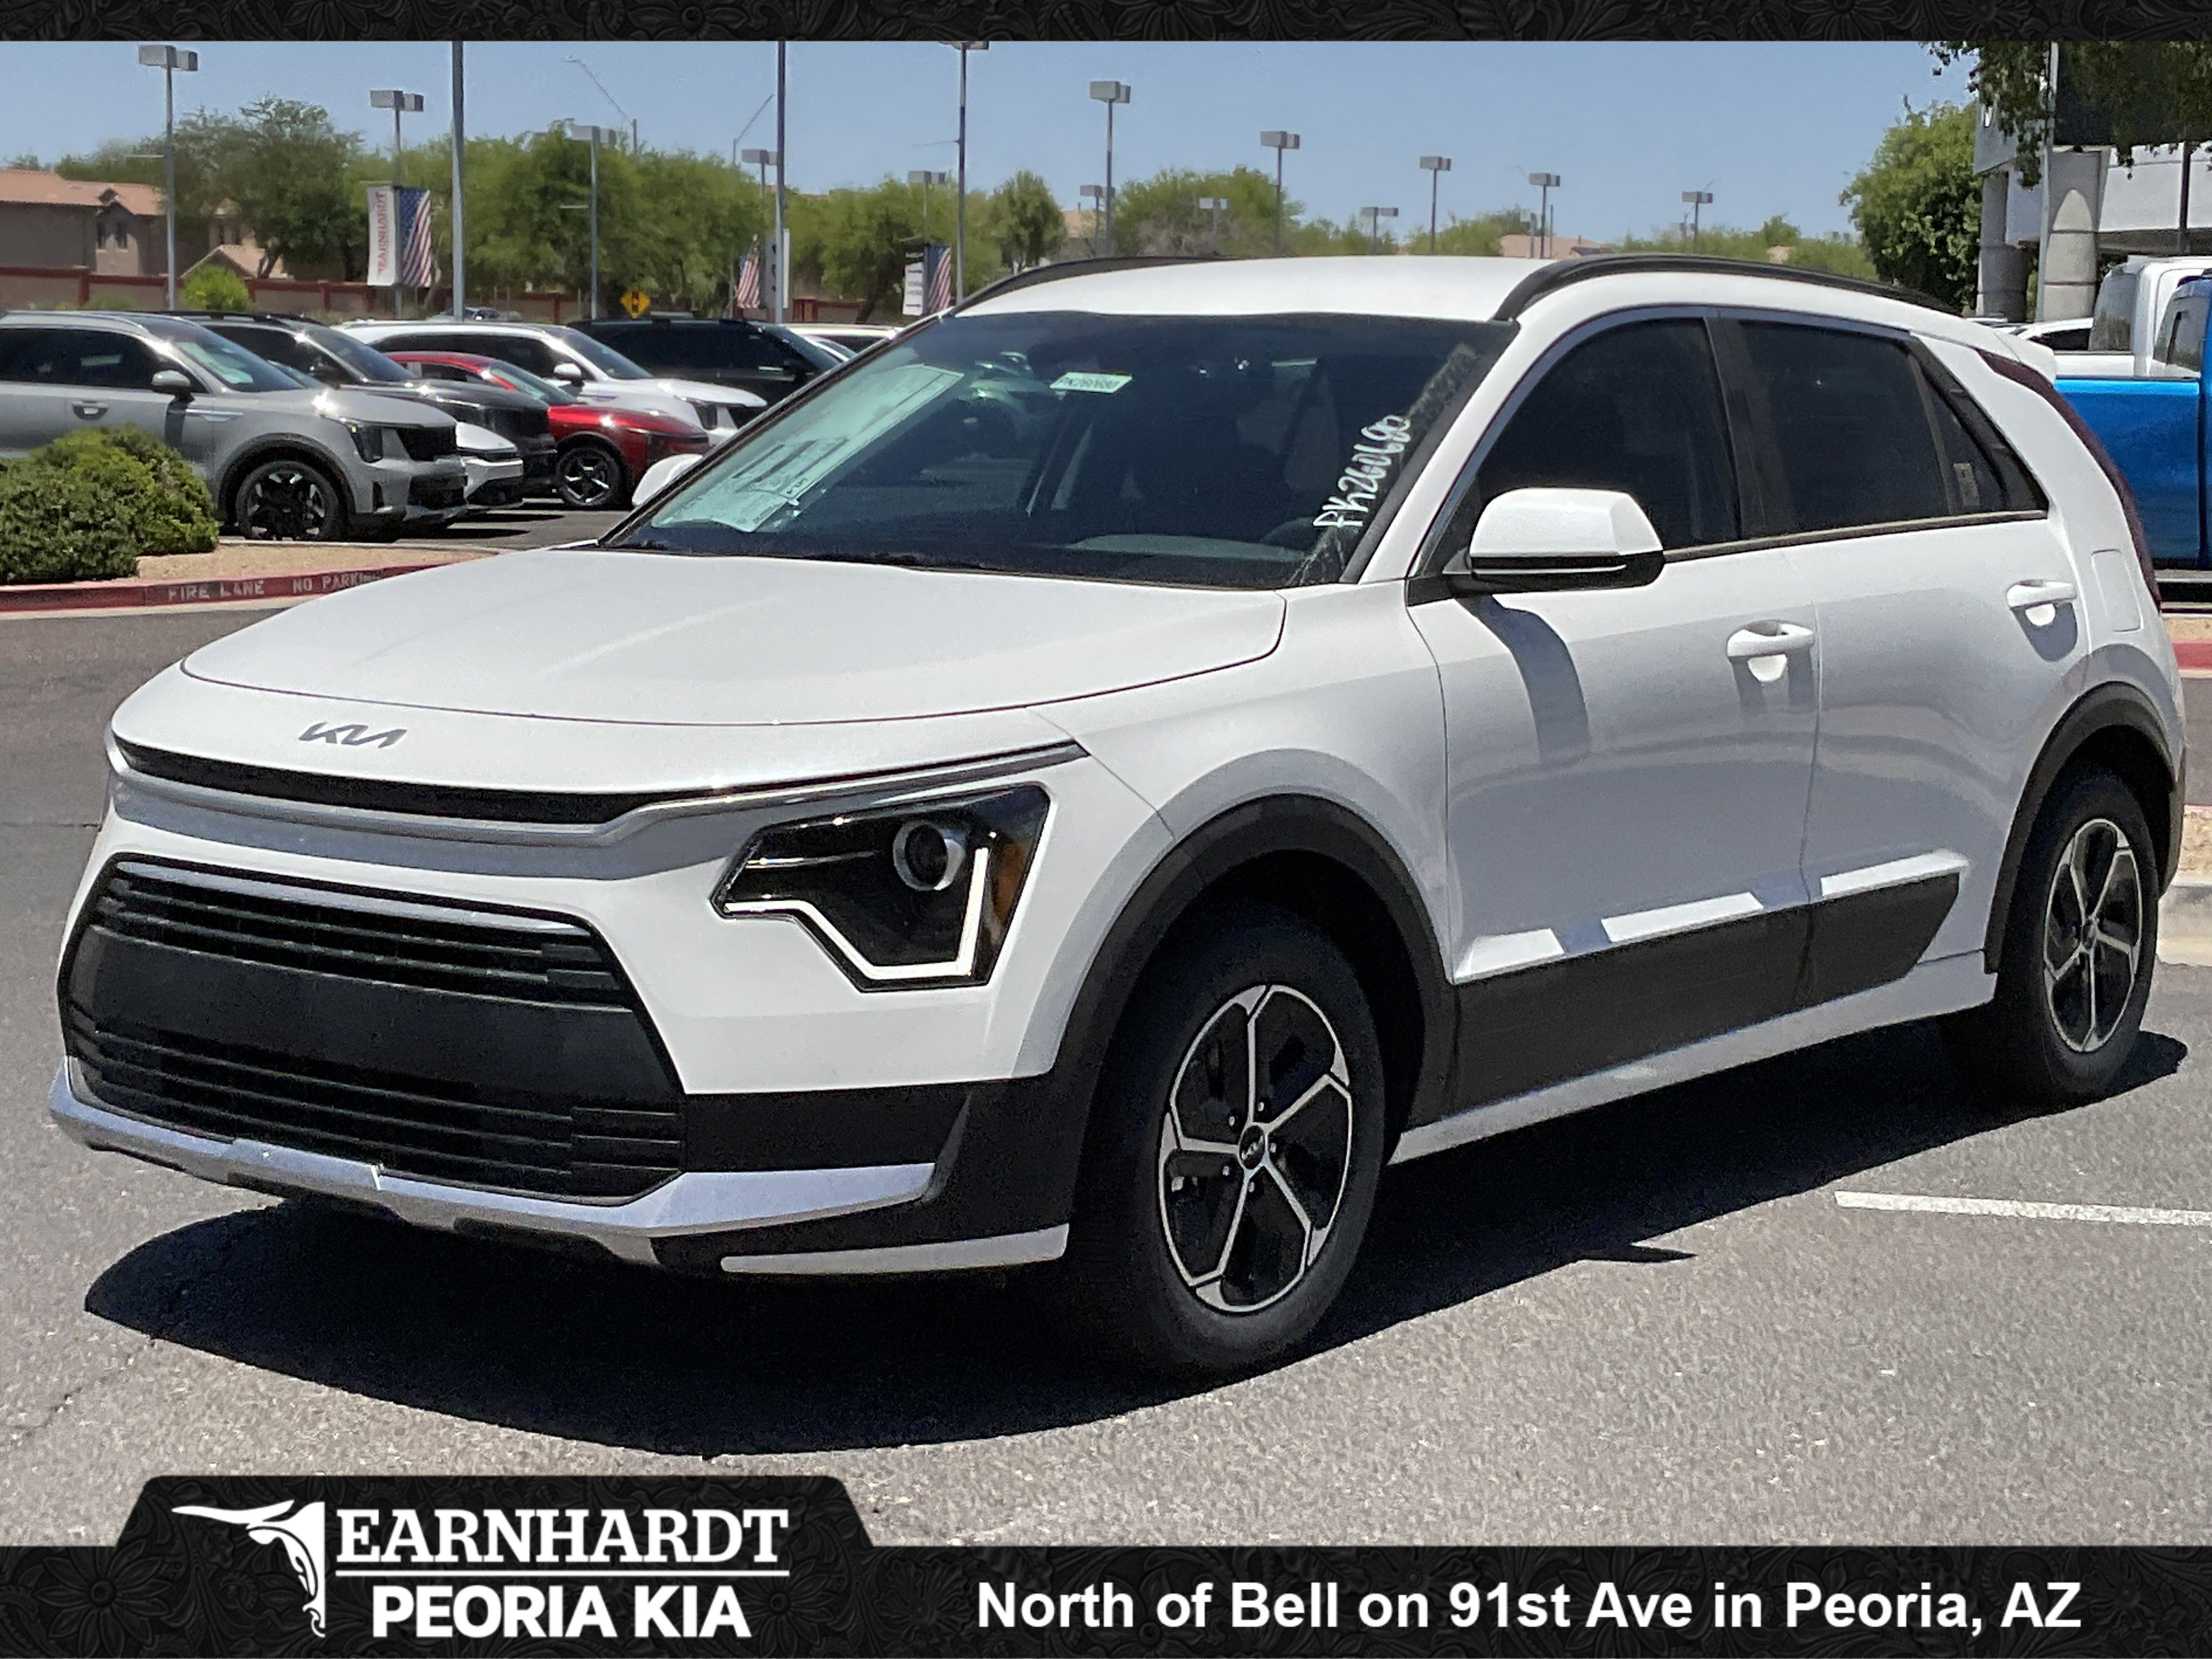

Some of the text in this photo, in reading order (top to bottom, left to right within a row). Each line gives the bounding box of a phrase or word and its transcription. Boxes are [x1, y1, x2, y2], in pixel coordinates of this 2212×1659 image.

[168, 585, 210, 602] FIRE
[221, 580, 264, 597] LANE
[292, 578, 312, 594] NO
[298, 721, 408, 748] KIA
